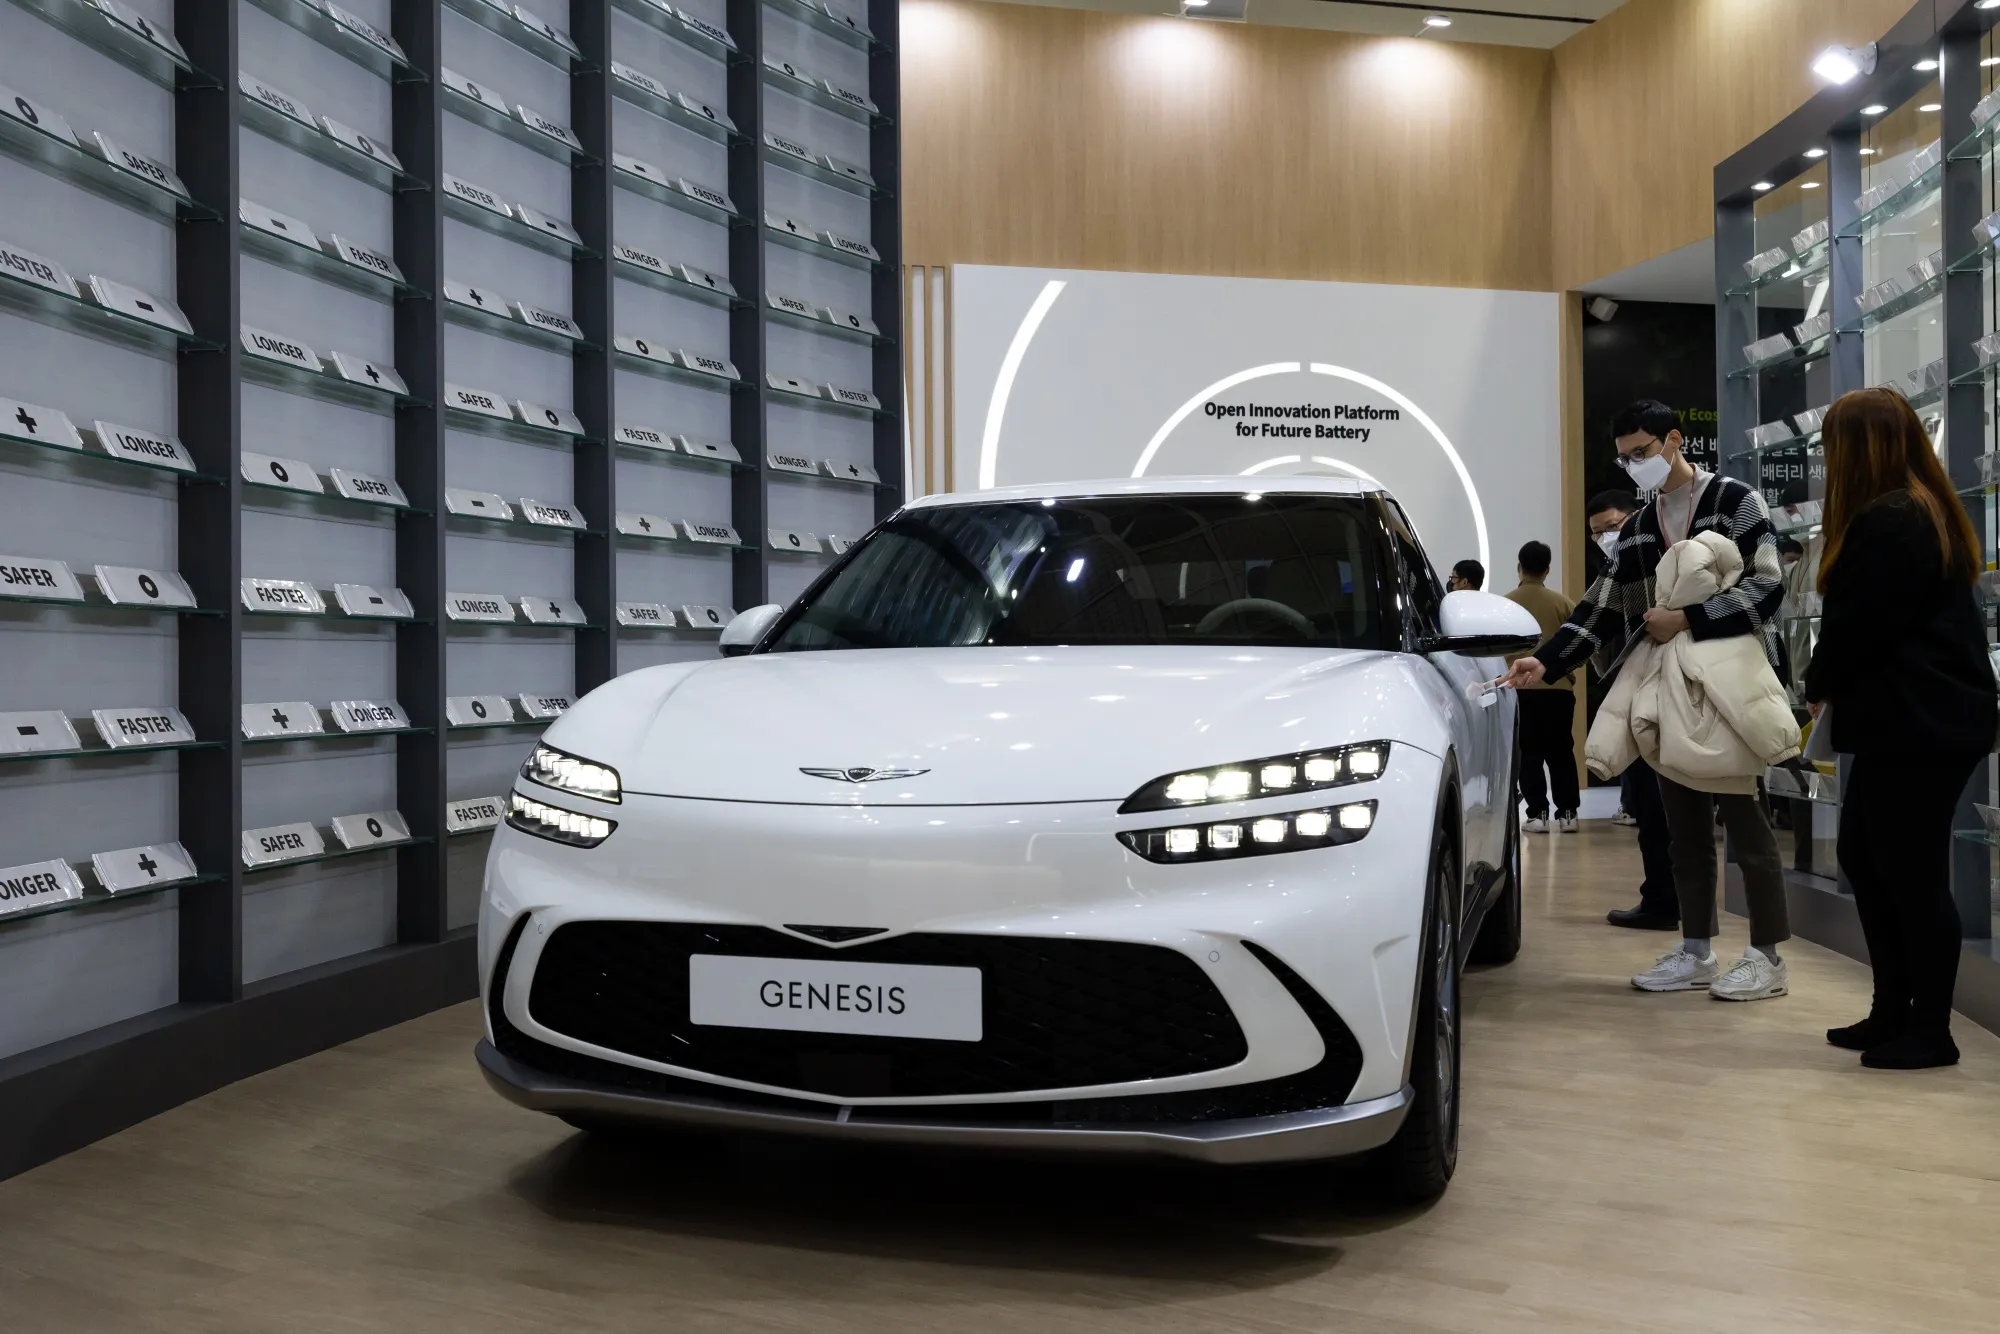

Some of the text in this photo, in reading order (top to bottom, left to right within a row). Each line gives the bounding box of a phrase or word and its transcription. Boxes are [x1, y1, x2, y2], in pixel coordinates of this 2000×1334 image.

[343, 15, 392, 48] LONGER
[689, 16, 726, 40] LONGER
[627, 70, 655, 91] SAFER
[256, 85, 300, 117] SAFER
[839, 89, 866, 105] SAFER
[535, 117, 567, 139] SAFER
[774, 138, 806, 156] FASTER
[122, 151, 169, 184] SAFER
[455, 182, 496, 207] FASTER
[692, 186, 727, 206] FASTER
[838, 238, 870, 254] LONGER
[349, 247, 391, 273] FASTER
[621, 247, 661, 268] LONGER
[779, 297, 806, 312] SAFER
[530, 310, 572, 332] LONGER
[252, 334, 306, 361] LONGER
[695, 356, 726, 373] SAFER
[457, 392, 495, 410] SAFER
[838, 387, 869, 404] FASTER
[1204, 402, 1399, 420] Open Innovation Platform
[623, 427, 661, 445] FASTER
[1236, 422, 1370, 442] for Future Battery
[116, 433, 179, 460] LONGER
[774, 454, 809, 471] LONGER
[1762, 463, 1803, 482] 배터리
[353, 479, 391, 497] SAFER
[535, 505, 572, 523] FASTER
[693, 524, 731, 540] LONGER
[0, 565, 57, 588] SAFER
[257, 587, 307, 604] FASTER
[456, 599, 502, 614] LONGER
[628, 607, 660, 621] SAFER
[538, 697, 570, 711] SAFER
[347, 707, 396, 722] LONGER
[117, 716, 175, 735] FASTER
[454, 805, 499, 822] FASTER
[260, 833, 305, 853] SAFER
[0, 872, 61, 900] ONGER
[760, 980, 906, 1015] GENESIS
